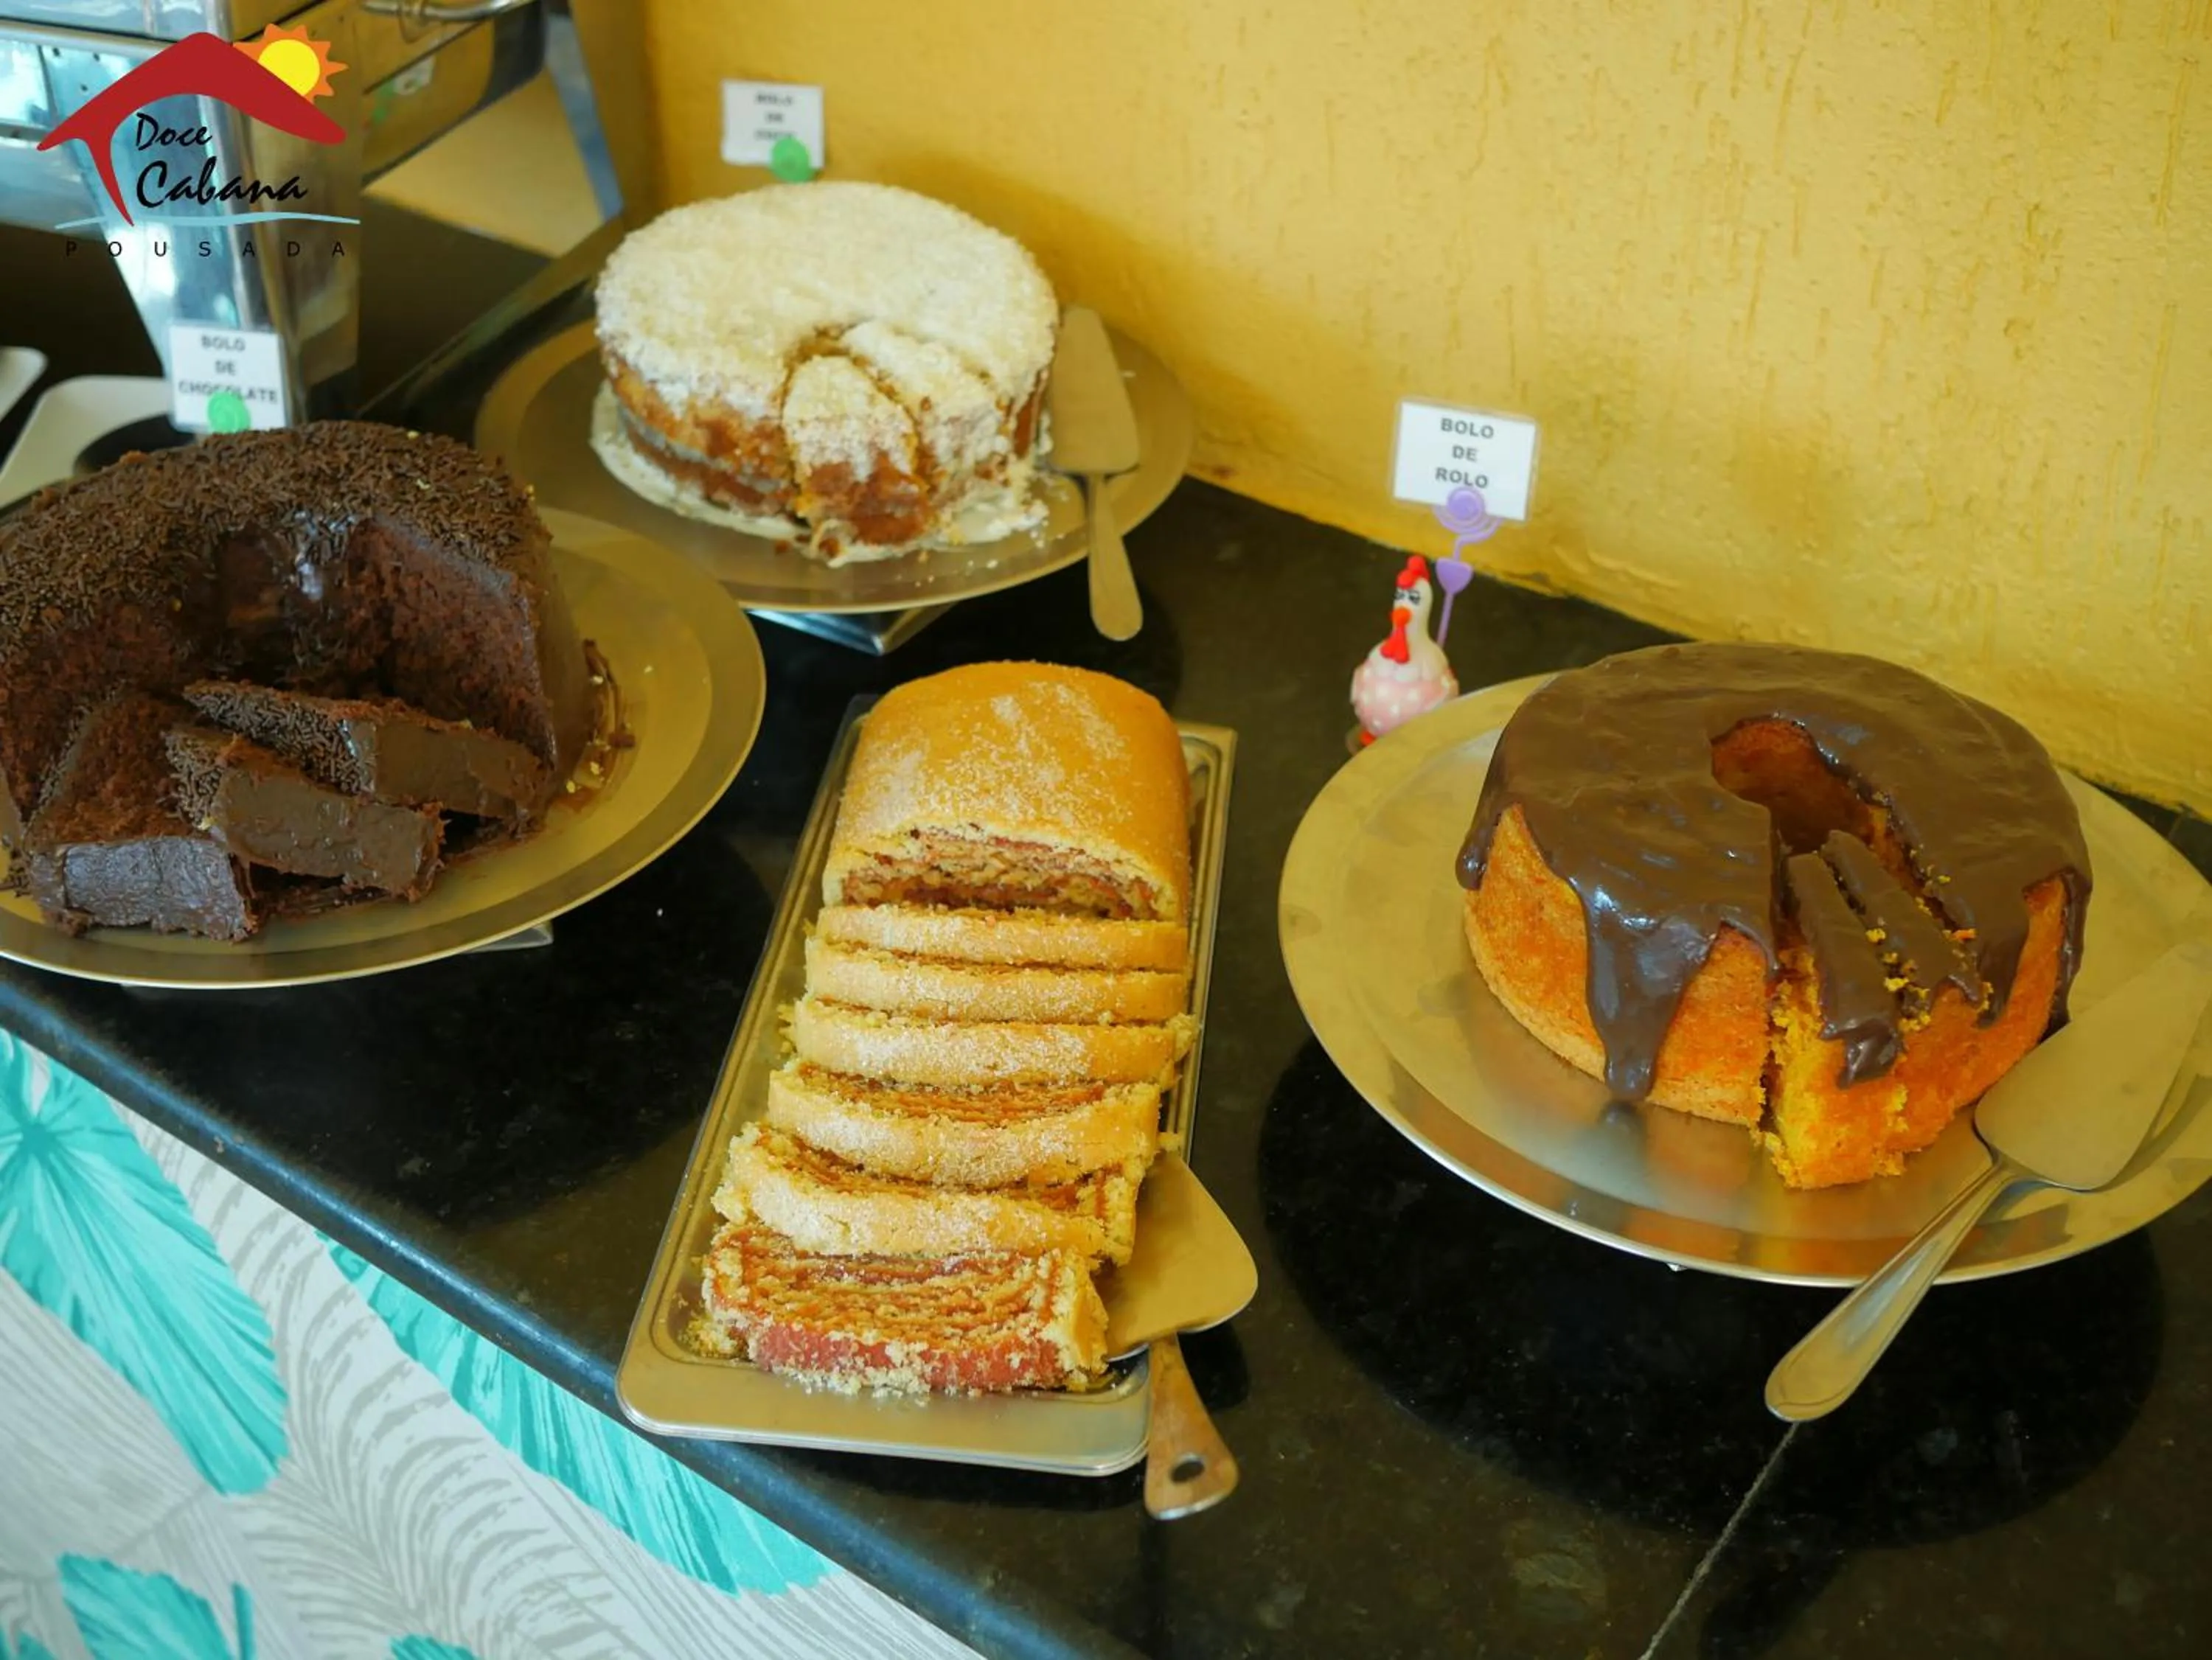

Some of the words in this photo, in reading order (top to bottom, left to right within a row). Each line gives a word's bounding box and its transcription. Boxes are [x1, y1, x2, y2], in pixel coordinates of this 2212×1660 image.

[201, 335, 246, 352] BOLO
[215, 359, 236, 376] DE
[1440, 417, 1495, 439] BOLO
[1452, 444, 1478, 462] DE
[1435, 467, 1489, 489] ROLO
